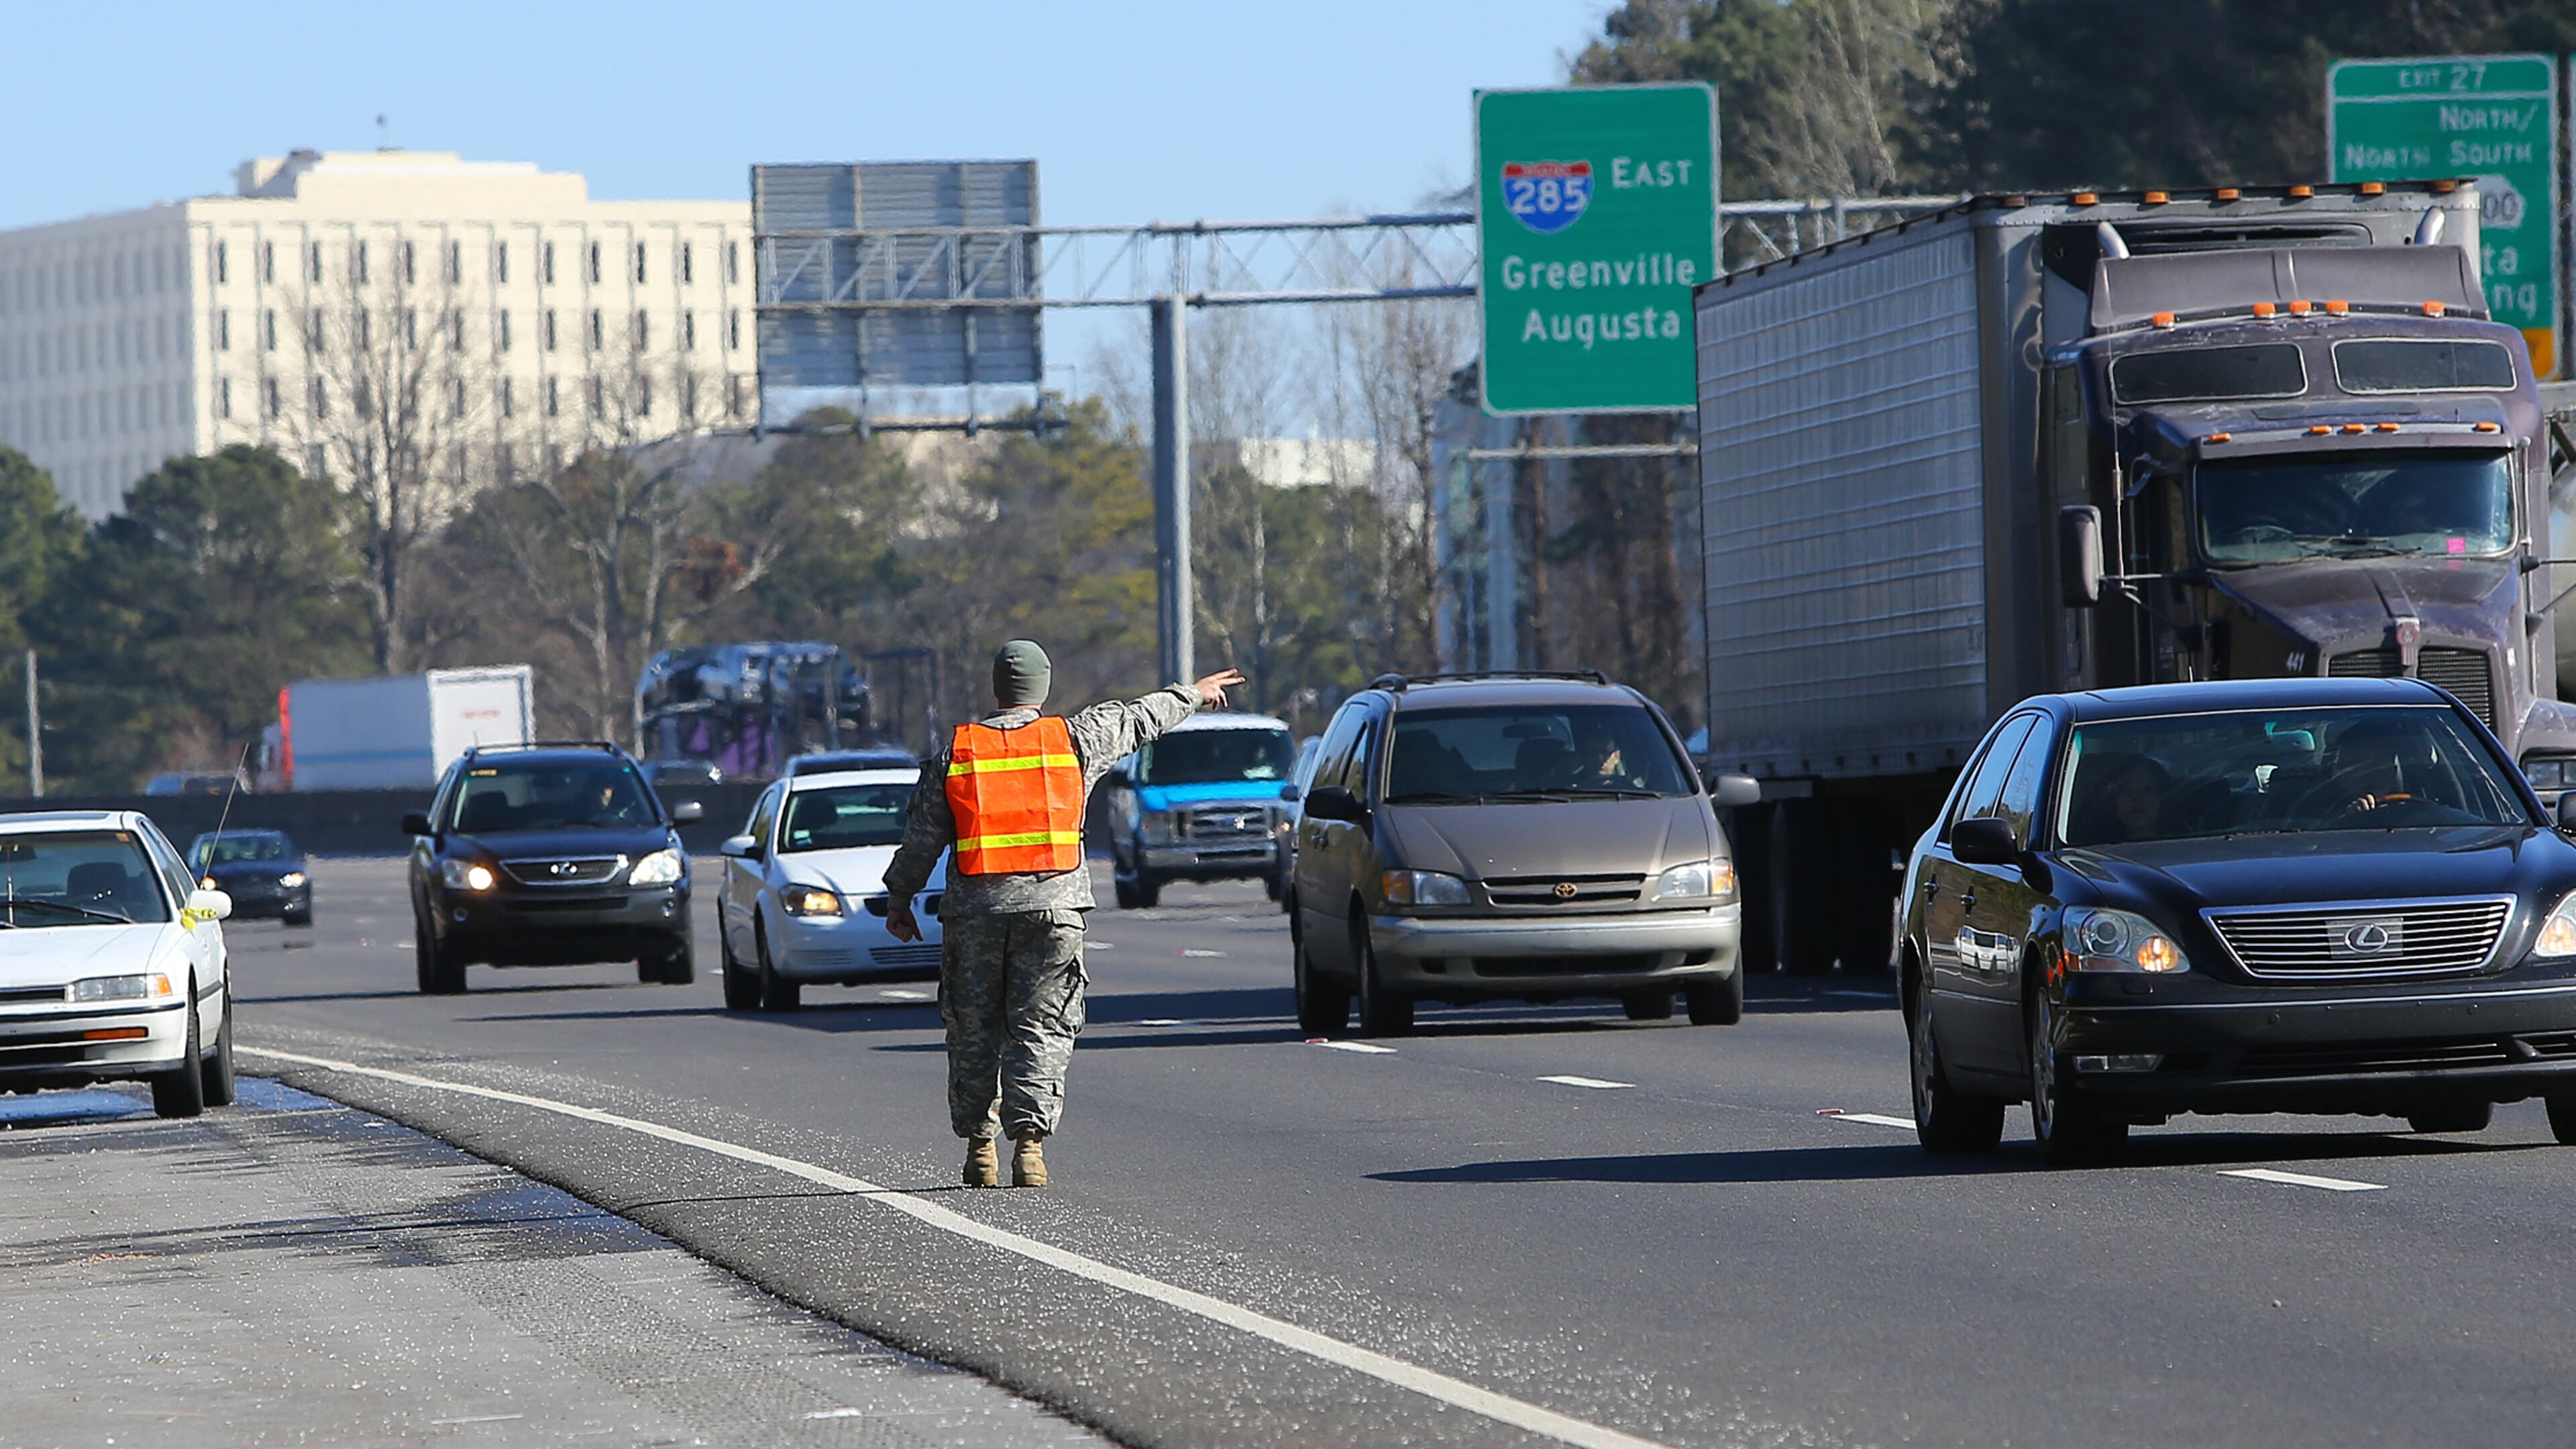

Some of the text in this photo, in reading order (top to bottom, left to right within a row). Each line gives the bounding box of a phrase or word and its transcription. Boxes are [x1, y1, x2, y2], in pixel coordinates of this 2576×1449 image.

[2399, 64, 2486, 91] EXIT 27
[2344, 139, 2532, 169] NORTH SOUTH
[1611, 155, 1694, 189] EAST
[1512, 178, 1589, 214] 285
[2482, 191, 2517, 221] 00
[1501, 252, 1697, 291] Greenville
[2481, 243, 2519, 276] ta
[2491, 281, 2537, 321] ng
[1521, 305, 1681, 352] Augusta
